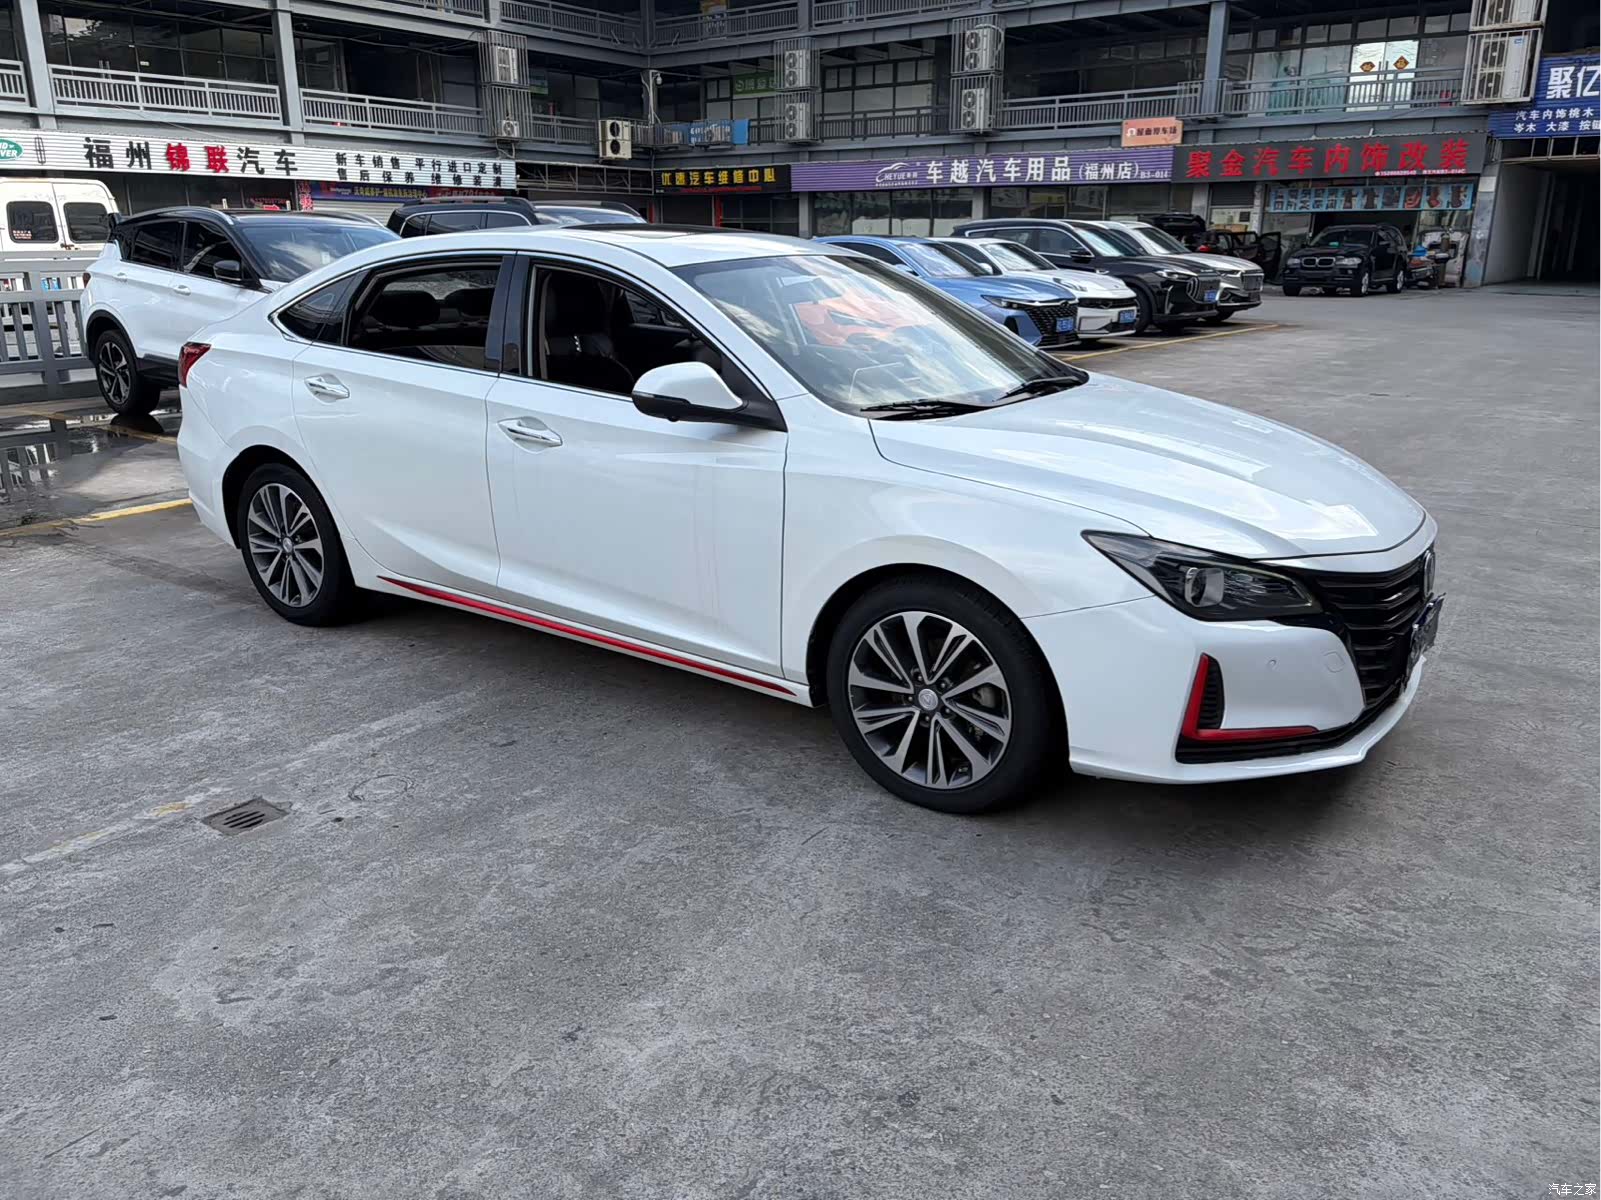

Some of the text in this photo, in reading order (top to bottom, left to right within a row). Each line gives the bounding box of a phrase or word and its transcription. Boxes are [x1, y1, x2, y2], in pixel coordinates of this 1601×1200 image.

[1546, 65, 1600, 99] 聚亿
[84, 137, 298, 176] 福州锦联汽车
[1186, 138, 1470, 178] 聚金汽车内饰改装
